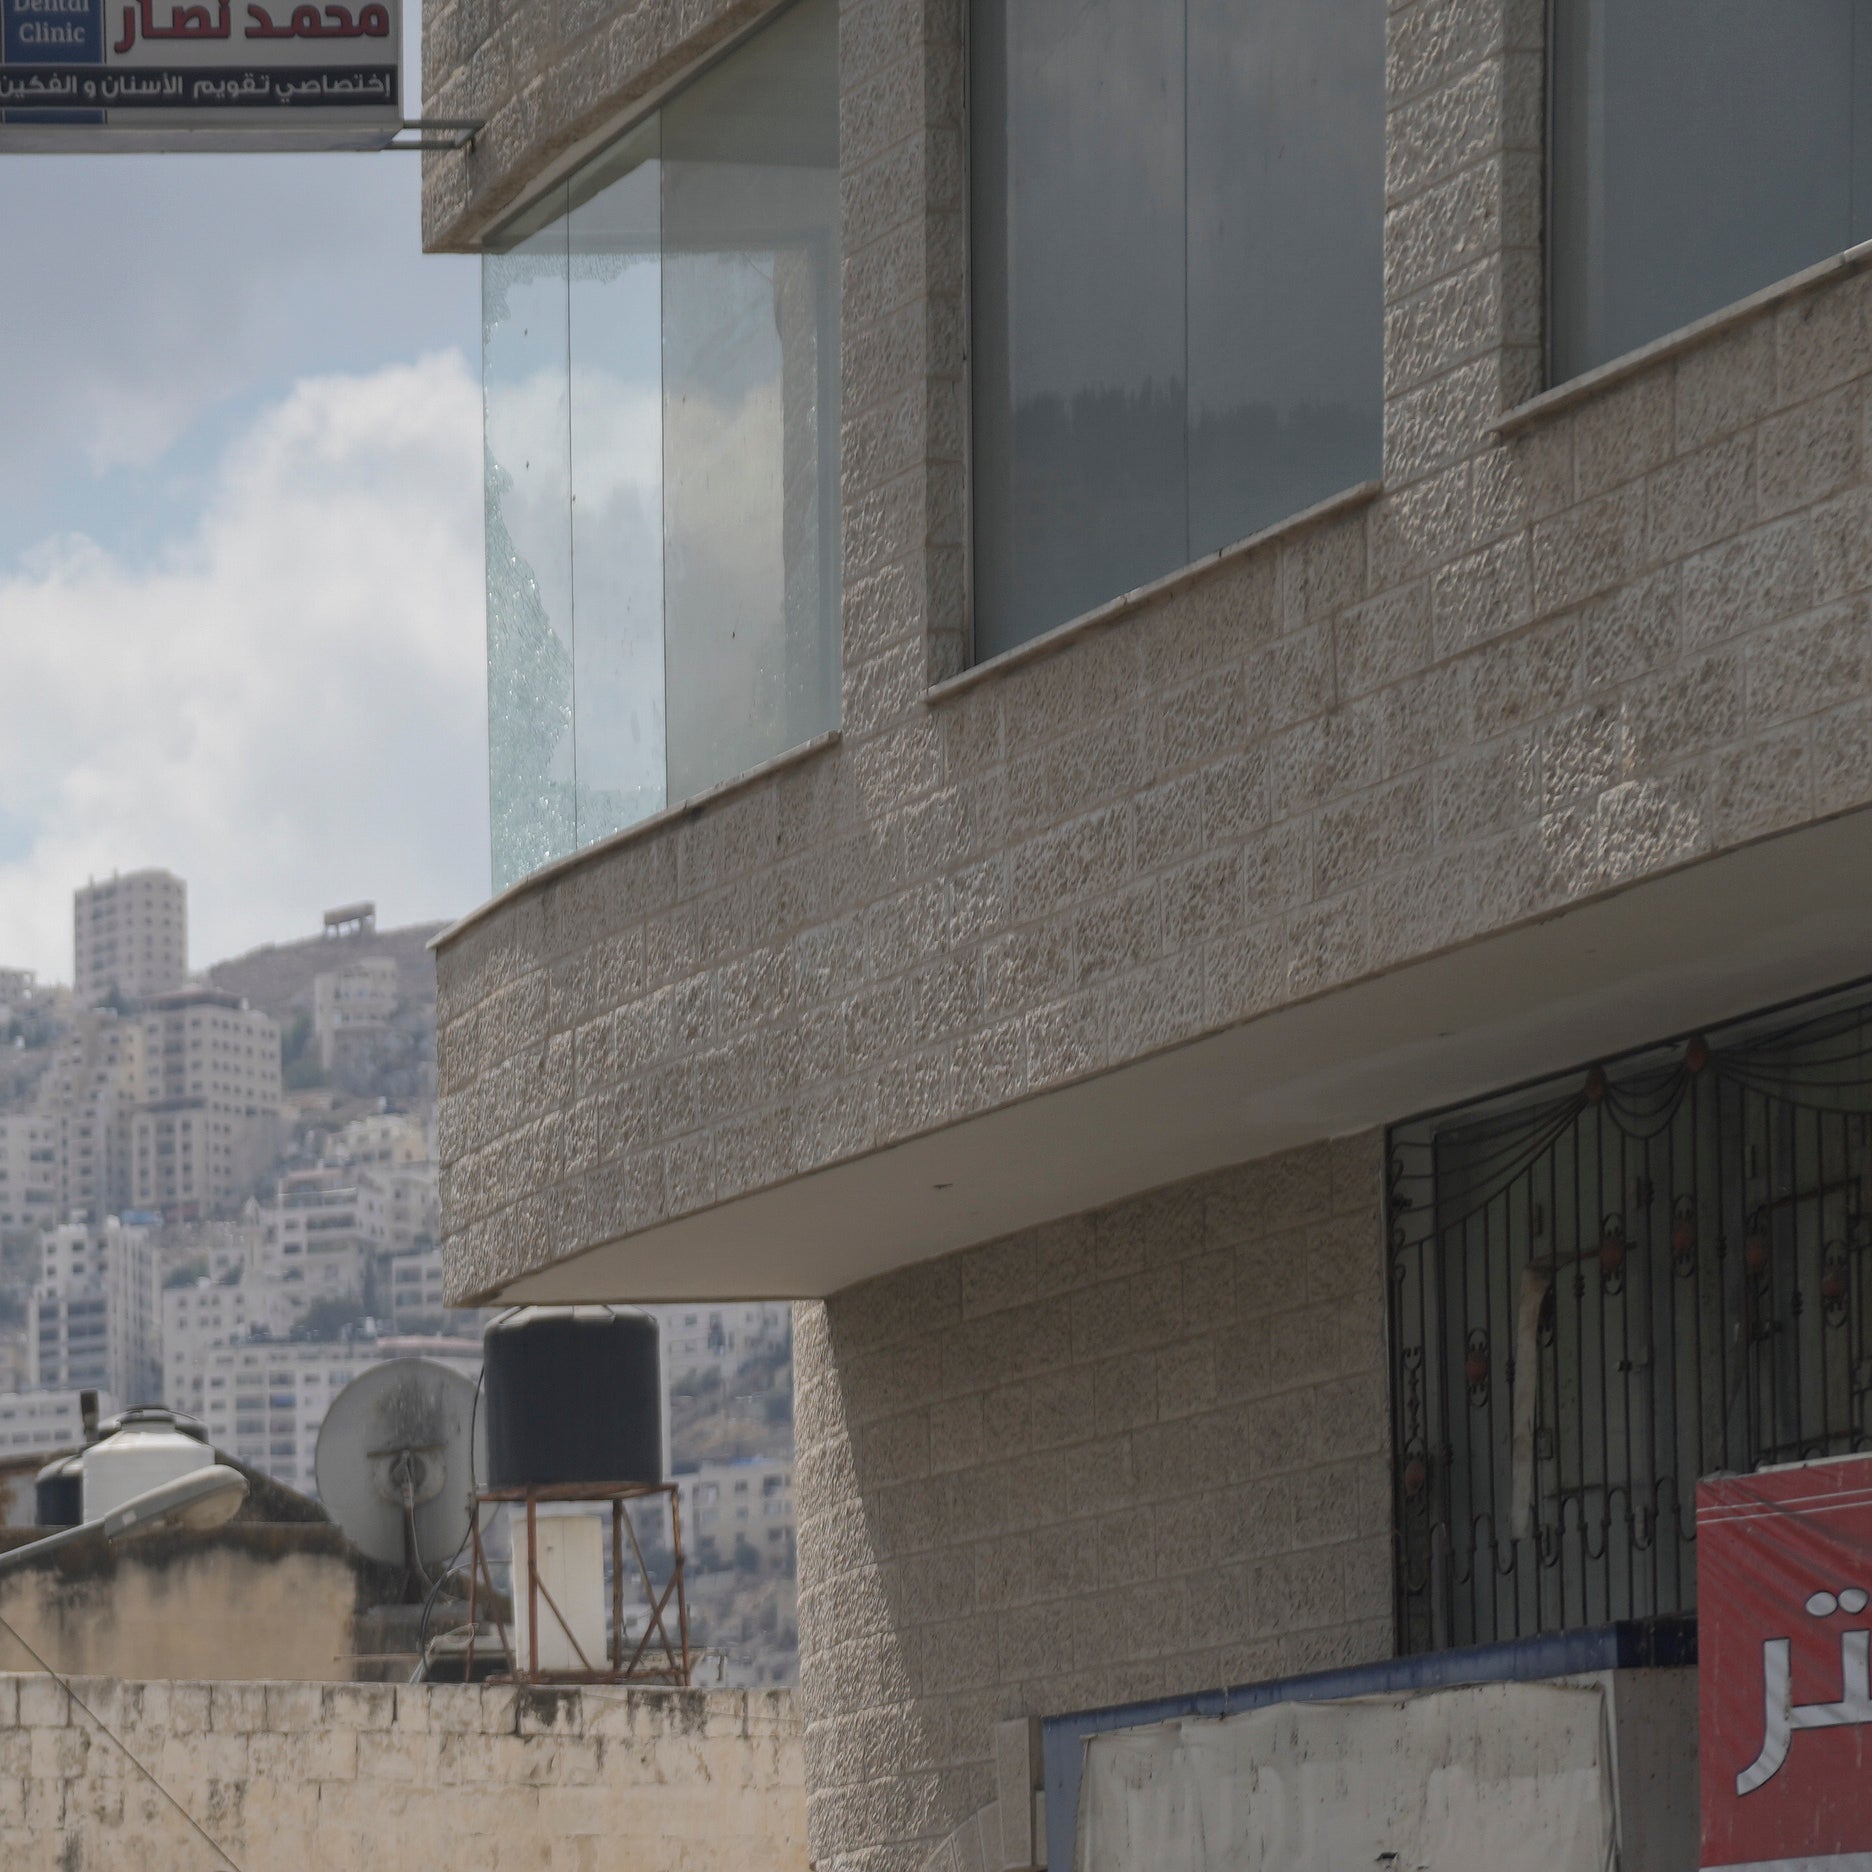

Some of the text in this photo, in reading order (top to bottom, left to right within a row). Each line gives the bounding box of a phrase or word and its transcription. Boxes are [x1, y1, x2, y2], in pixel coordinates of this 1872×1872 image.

[244, 3, 388, 38] محمد
[18, 23, 86, 44] Clinic
[101, 74, 184, 97] الأسنان
[192, 75, 270, 99] تقويم
[1737, 1588, 1872, 1796] تر
